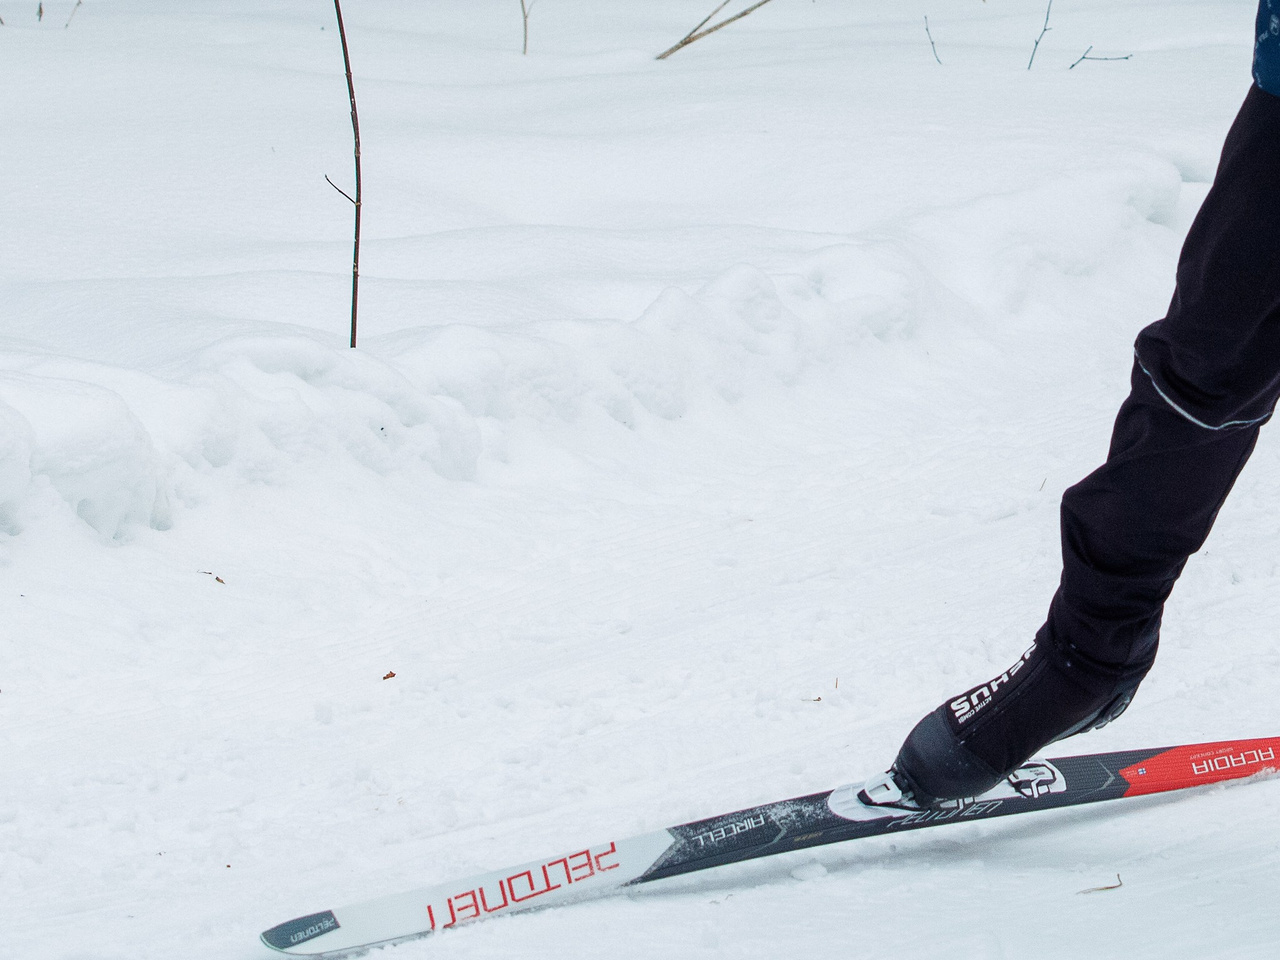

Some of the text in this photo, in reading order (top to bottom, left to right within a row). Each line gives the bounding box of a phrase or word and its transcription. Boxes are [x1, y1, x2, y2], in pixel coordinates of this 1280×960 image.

[1191, 746, 1275, 775] ACADIA
[691, 813, 767, 847] AIRCELL
[427, 841, 621, 931] PELTONEN
[291, 917, 336, 944] PELTONEN
